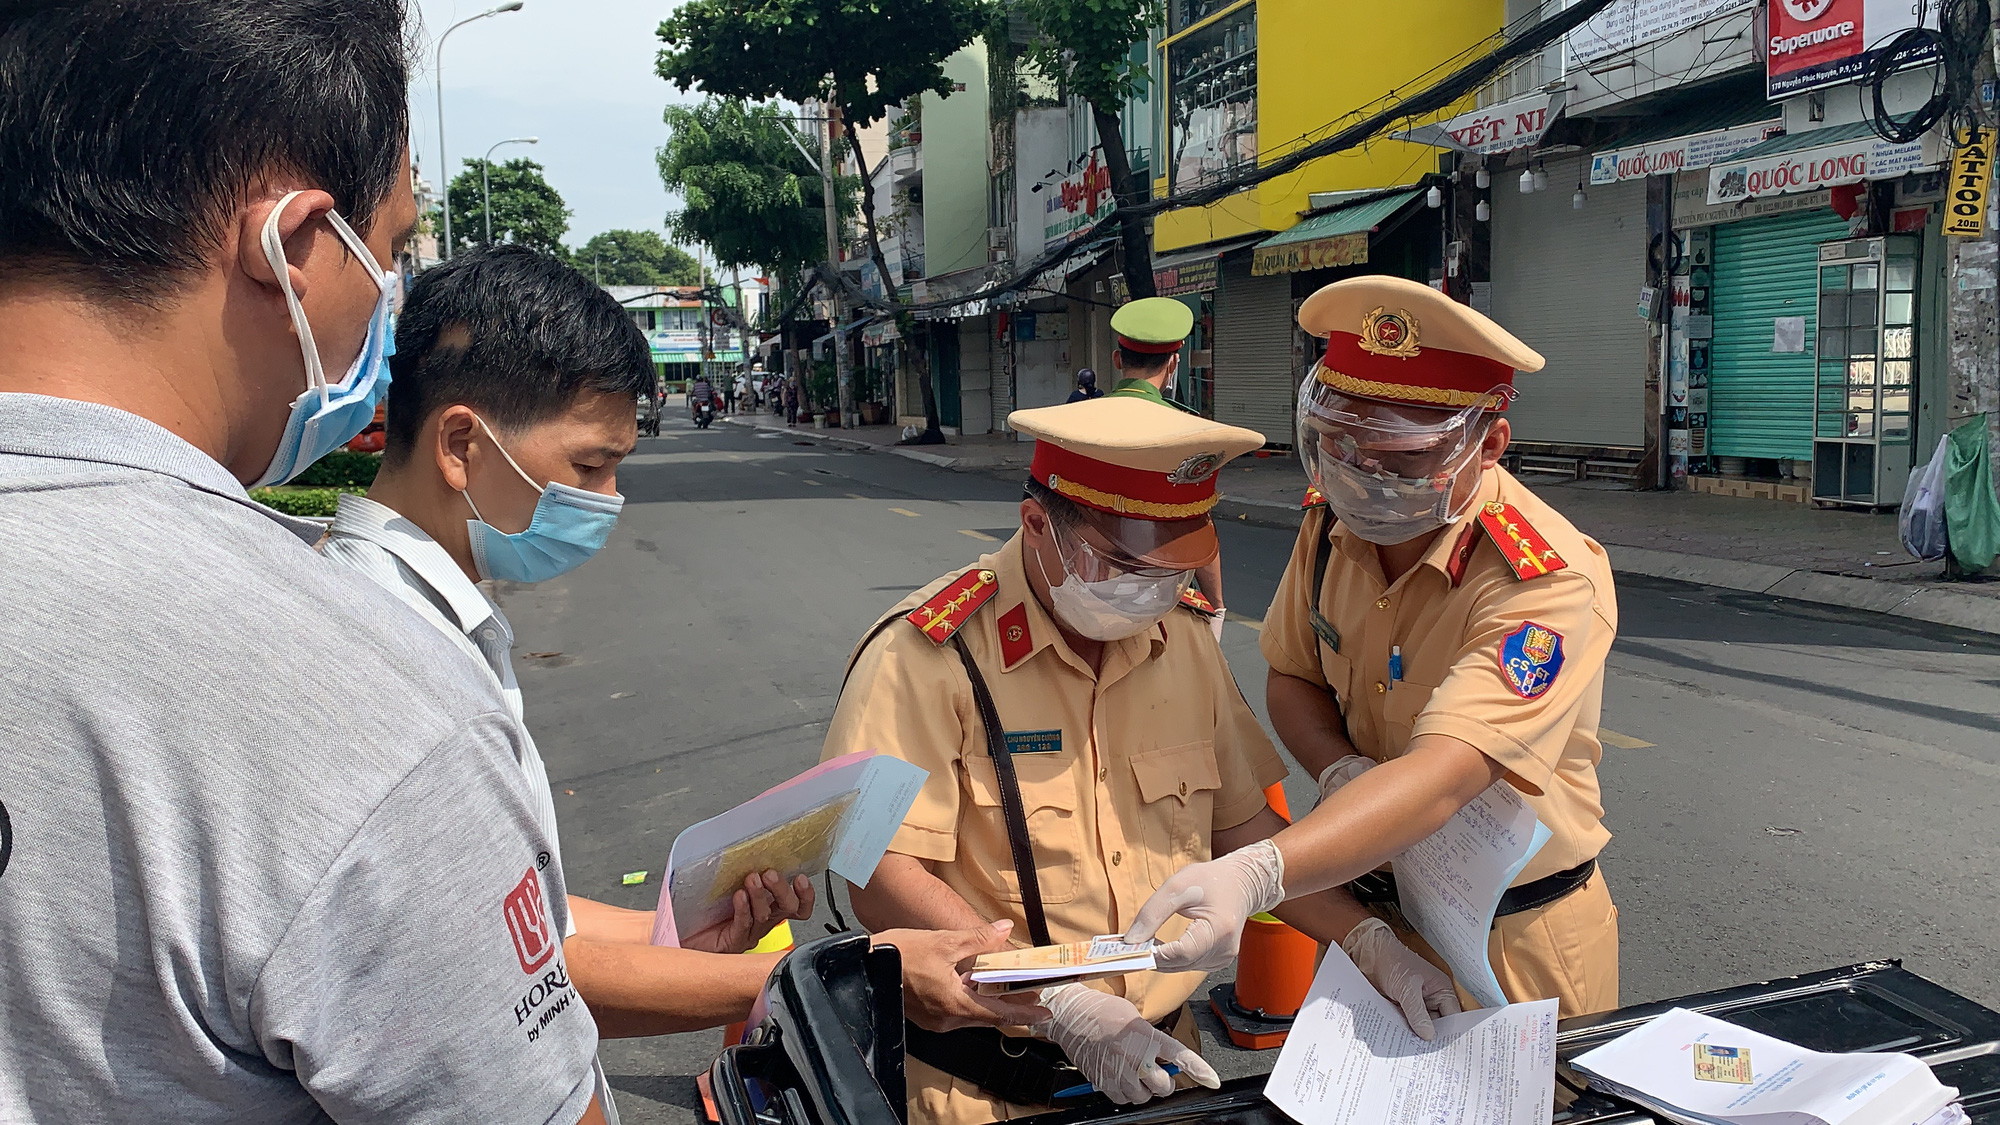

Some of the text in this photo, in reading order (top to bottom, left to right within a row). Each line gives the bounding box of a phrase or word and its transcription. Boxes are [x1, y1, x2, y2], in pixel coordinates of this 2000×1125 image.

[1770, 21, 1855, 56] Superware
[1771, 77, 1782, 91] 170
[1618, 151, 1651, 179] QUỐC
[1652, 149, 1686, 172] LONG
[1747, 152, 1868, 195] QUỐC LONG
[1953, 131, 1990, 217] TATTOO
[1957, 219, 1980, 228] 20m
[1510, 657, 1550, 682] CS GT
[527, 1023, 540, 1043] by
[539, 993, 570, 1030] MINH
